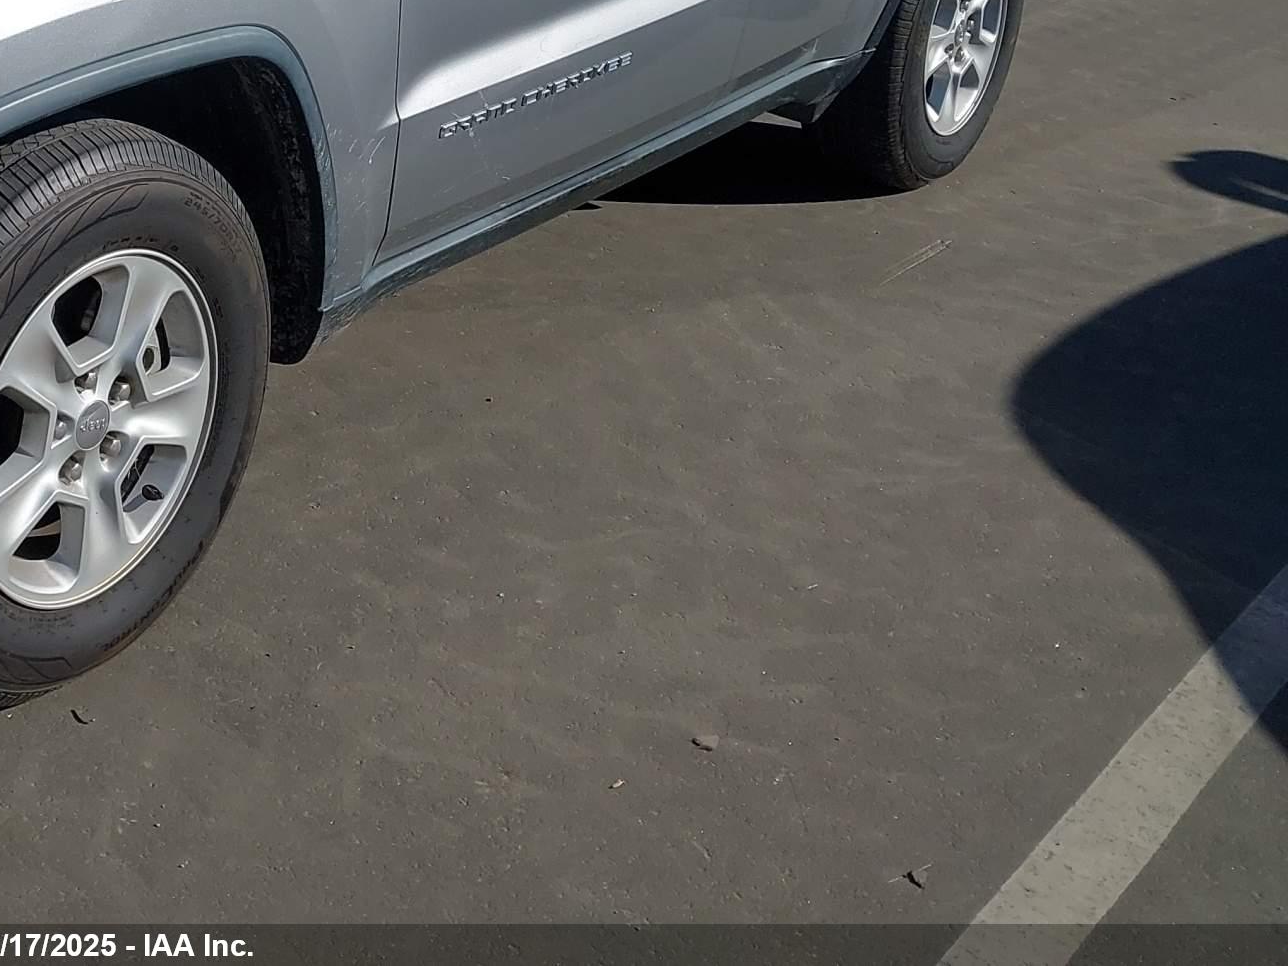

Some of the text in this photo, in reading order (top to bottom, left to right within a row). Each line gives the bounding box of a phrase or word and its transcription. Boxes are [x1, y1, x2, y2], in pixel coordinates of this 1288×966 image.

[438, 50, 633, 139] GRAND CHEROKEE
[79, 416, 106, 433] Jeep
